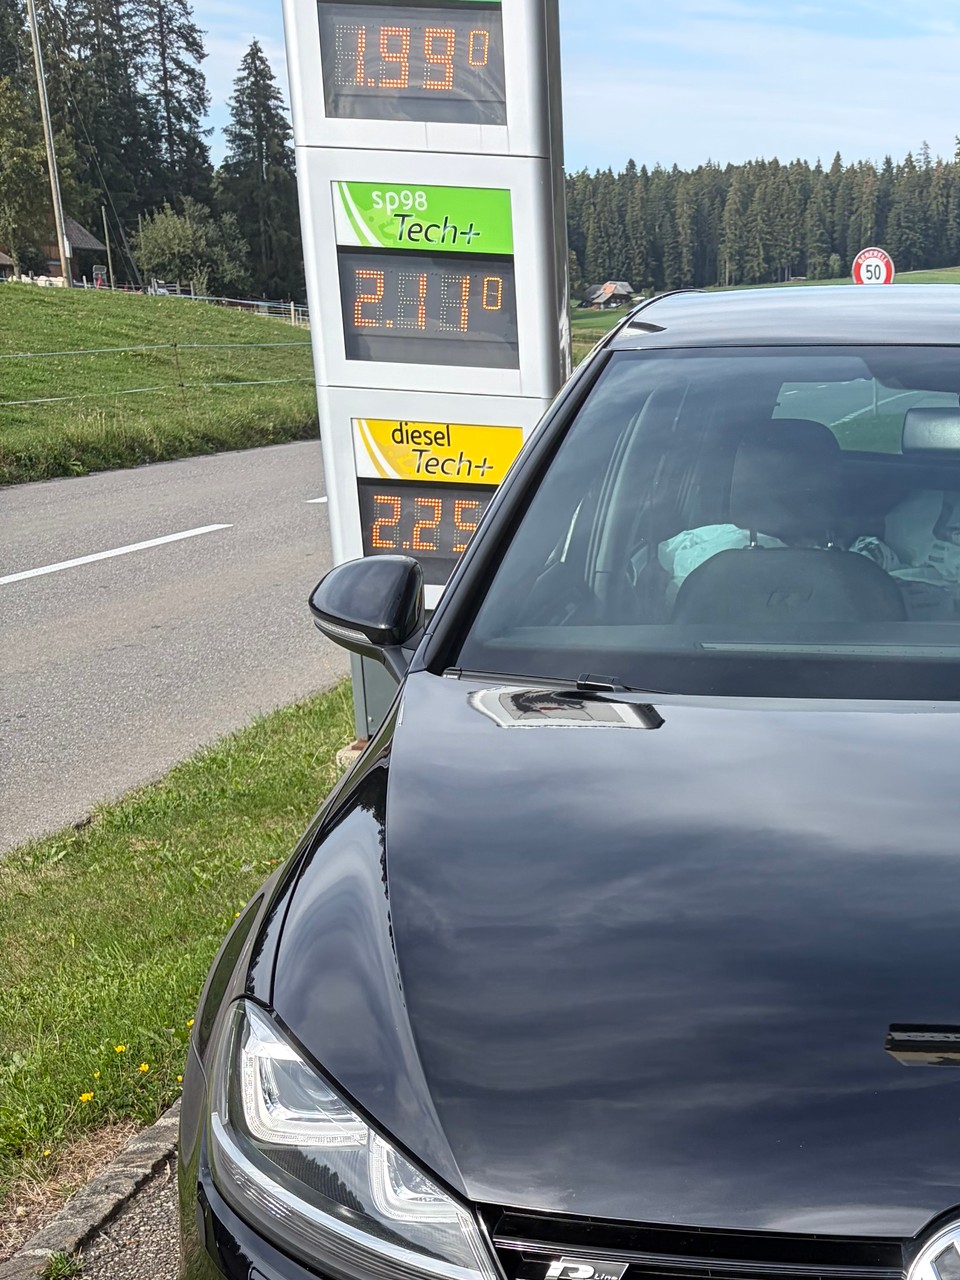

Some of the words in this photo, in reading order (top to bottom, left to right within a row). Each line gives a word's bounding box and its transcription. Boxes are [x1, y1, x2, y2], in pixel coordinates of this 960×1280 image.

[371, 190, 428, 214] sp98
[393, 214, 481, 245] Tech+
[865, 264, 881, 280] 50
[391, 421, 451, 447] diesel
[411, 448, 494, 477] Tech+
